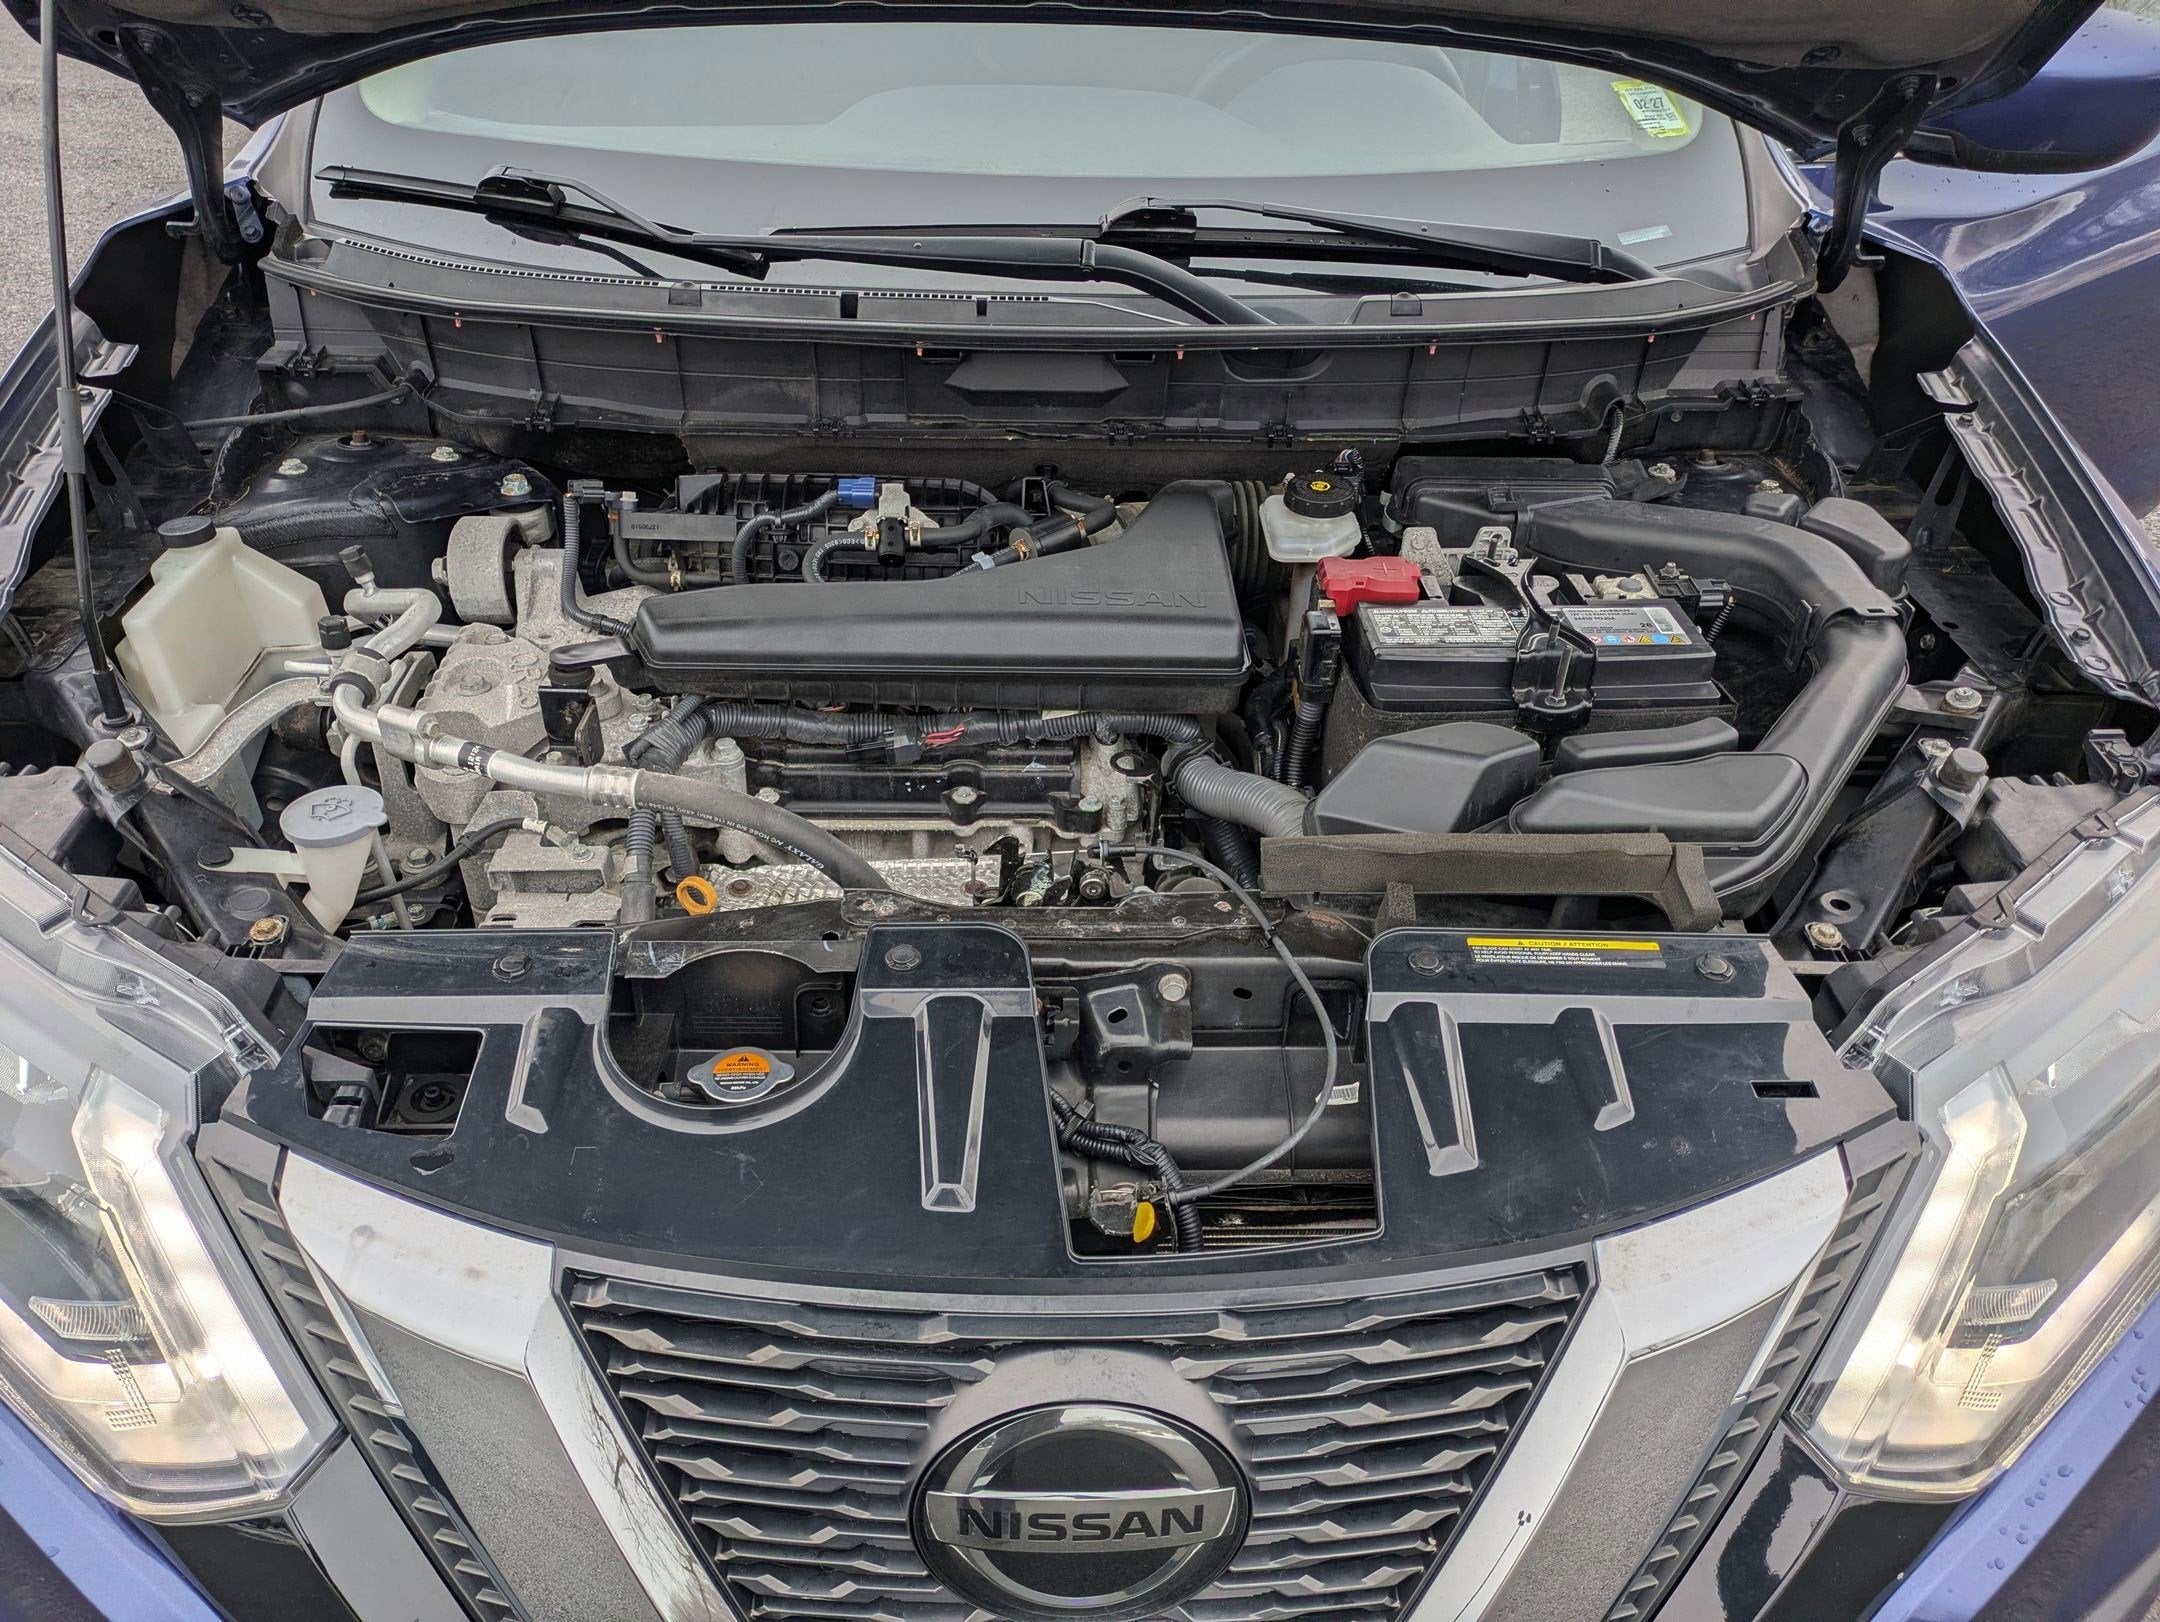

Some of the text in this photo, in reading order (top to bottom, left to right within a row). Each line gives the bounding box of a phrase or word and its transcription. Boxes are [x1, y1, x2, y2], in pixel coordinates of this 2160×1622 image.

[1018, 588, 1208, 608] NISSAN
[749, 828, 771, 843] HOSE
[787, 845, 825, 869] GALAXY
[959, 1504, 1205, 1543] NISSAN
